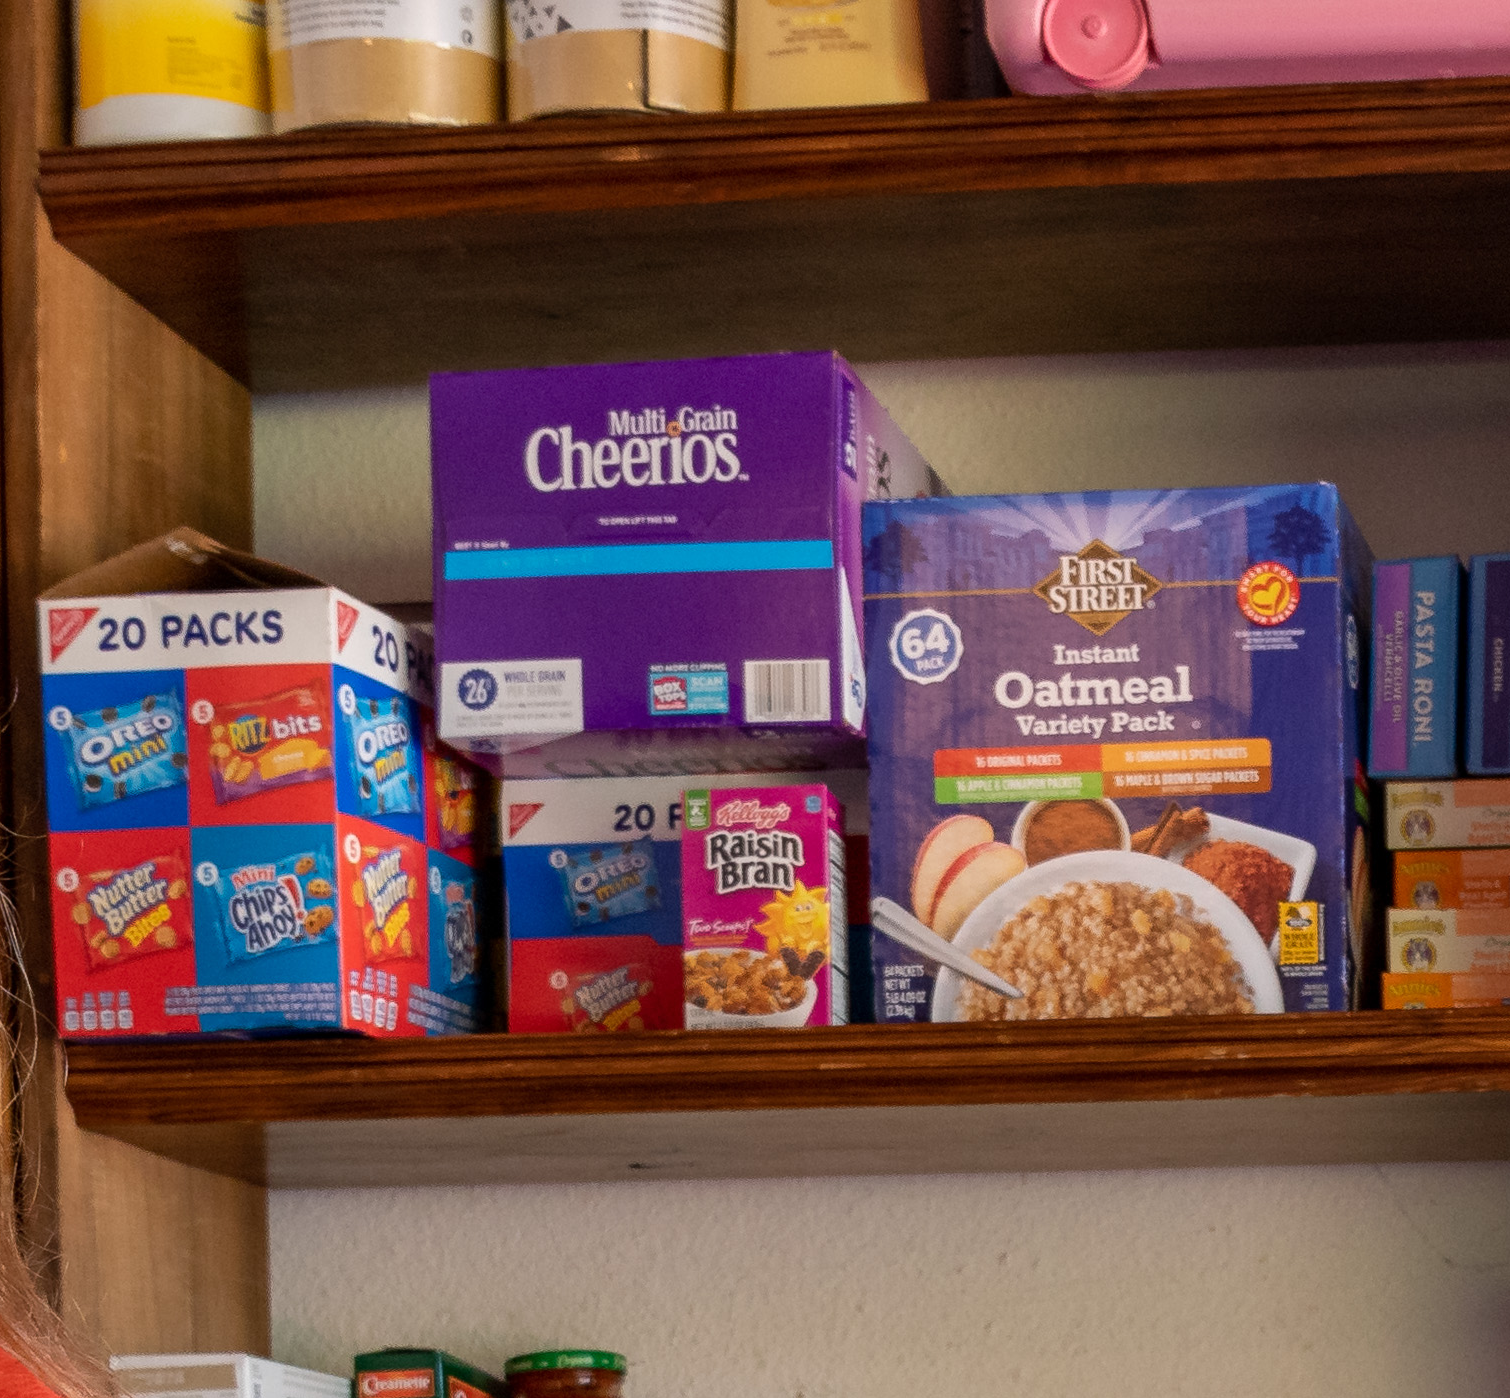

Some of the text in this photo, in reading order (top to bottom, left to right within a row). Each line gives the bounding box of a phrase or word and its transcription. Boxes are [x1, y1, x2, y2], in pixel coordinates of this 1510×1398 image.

[609, 404, 737, 436] Multi Grain
[525, 424, 742, 493] Cheerios
[1060, 555, 1137, 586] FIRST
[1049, 583, 1147, 613] STREET
[98, 610, 284, 651] 20 PACKS
[900, 623, 950, 655] 64
[915, 656, 945, 672] PACK
[1054, 644, 1140, 666] Instant
[1413, 591, 1435, 741] PASTA RONI
[995, 666, 1193, 709] Oatmeal
[81, 715, 172, 762] OREO
[231, 714, 322, 748] RITZ bits
[1016, 711, 1174, 738] Variety Pack
[110, 736, 166, 776] mini
[358, 723, 407, 761] OREO
[987, 753, 1062, 767] ORIGINAL PACKETS
[1224, 770, 1259, 783] PACKETS
[614, 805, 655, 832] 20
[710, 834, 801, 865] Raisin
[720, 862, 791, 890] Bran
